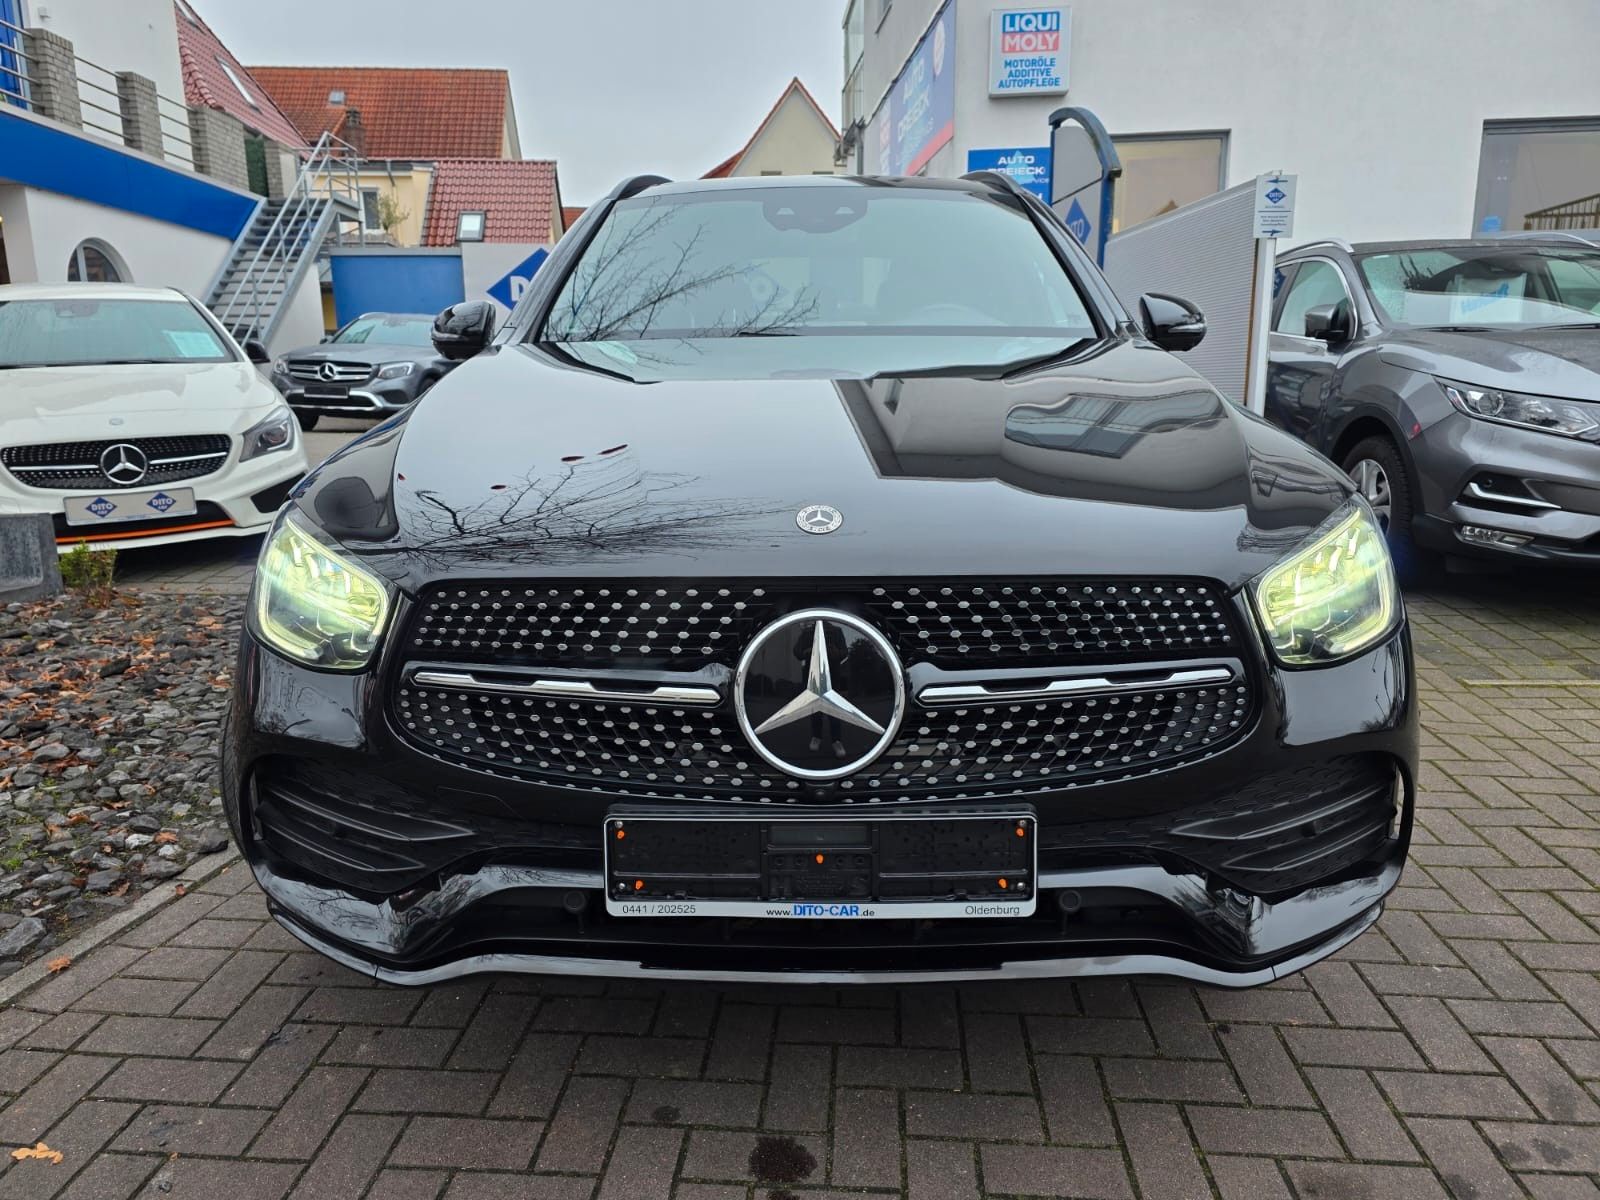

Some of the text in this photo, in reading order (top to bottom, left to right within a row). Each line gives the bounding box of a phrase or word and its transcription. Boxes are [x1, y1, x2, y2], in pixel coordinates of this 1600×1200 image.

[1004, 13, 1058, 33] LIQUI
[1004, 32, 1058, 52] MOLY
[1004, 56, 1056, 69] MOTORÖLE
[1008, 68, 1052, 78] ADDITIVE
[998, 77, 1060, 88] AUTOPFLEGE
[997, 155, 1035, 165] AUTO
[987, 166, 1046, 176] REIECK
[91, 503, 113, 511] DITO
[152, 498, 173, 506] DITO
[622, 904, 647, 914] 0441
[657, 904, 696, 914] 202525
[766, 904, 875, 917] www.DITO-CAR.de
[964, 905, 1020, 916] Oldenburg
